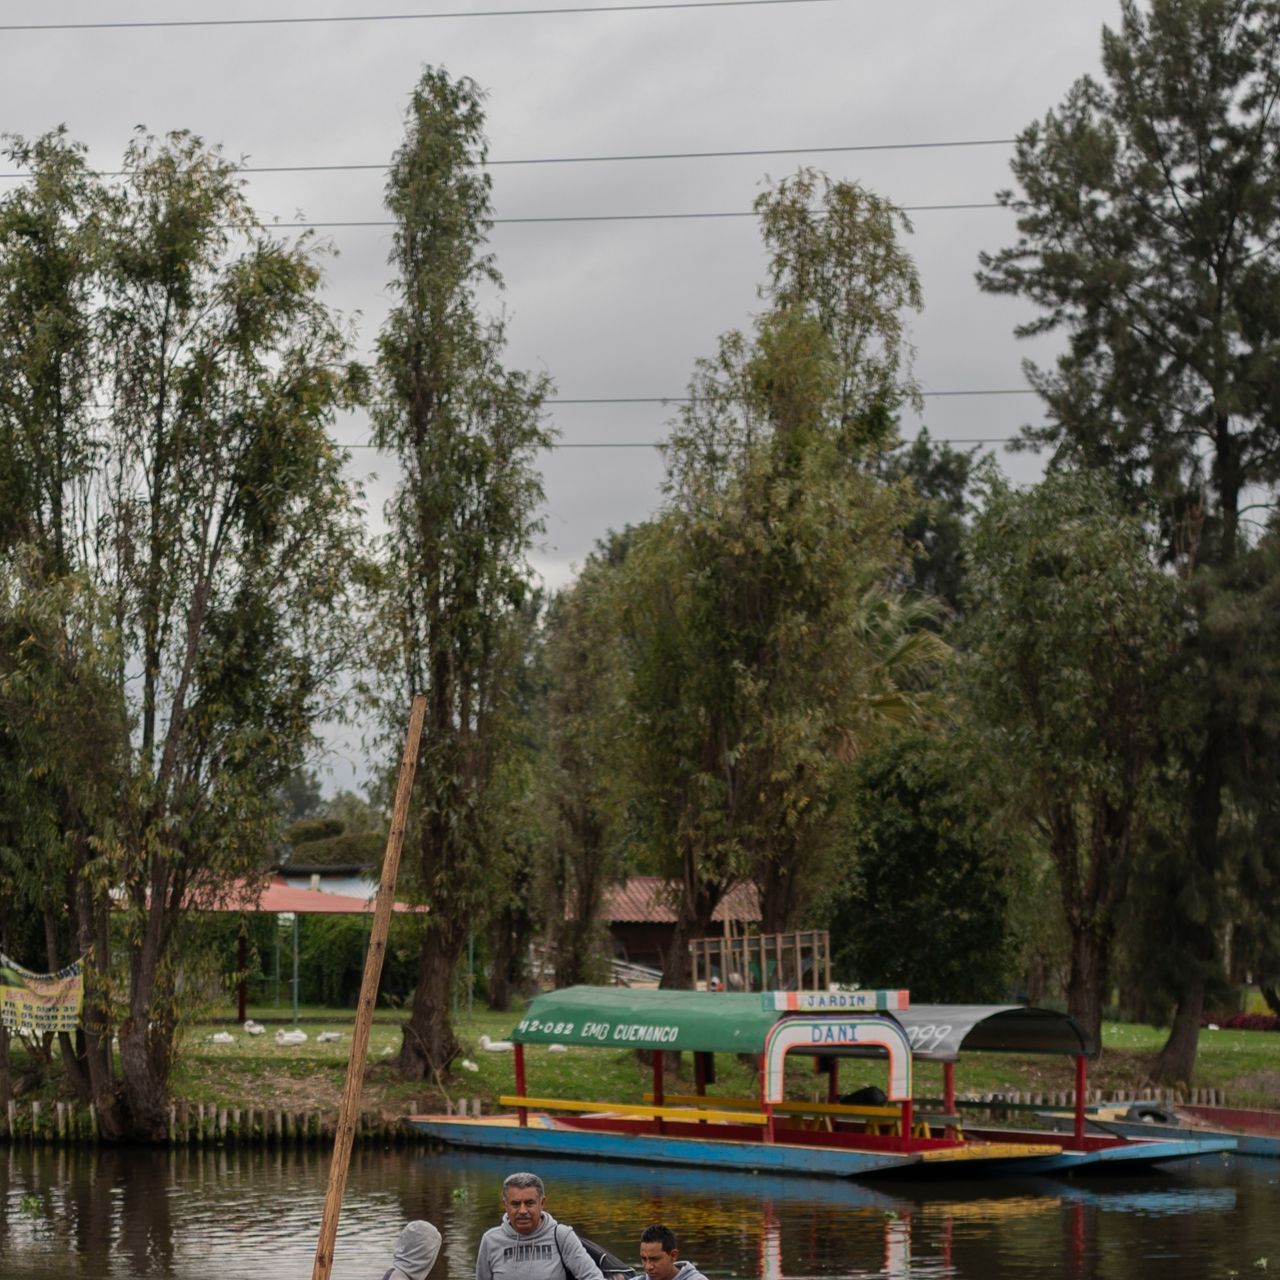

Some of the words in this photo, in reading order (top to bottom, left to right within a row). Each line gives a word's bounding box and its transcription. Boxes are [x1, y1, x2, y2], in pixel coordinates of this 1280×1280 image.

[807, 994, 866, 1007] JARDIN
[581, 1022, 610, 1040] EMB
[613, 1024, 679, 1042] CUEMANCO
[811, 1023, 858, 1042] DANI
[504, 1244, 553, 1262] PUMA
